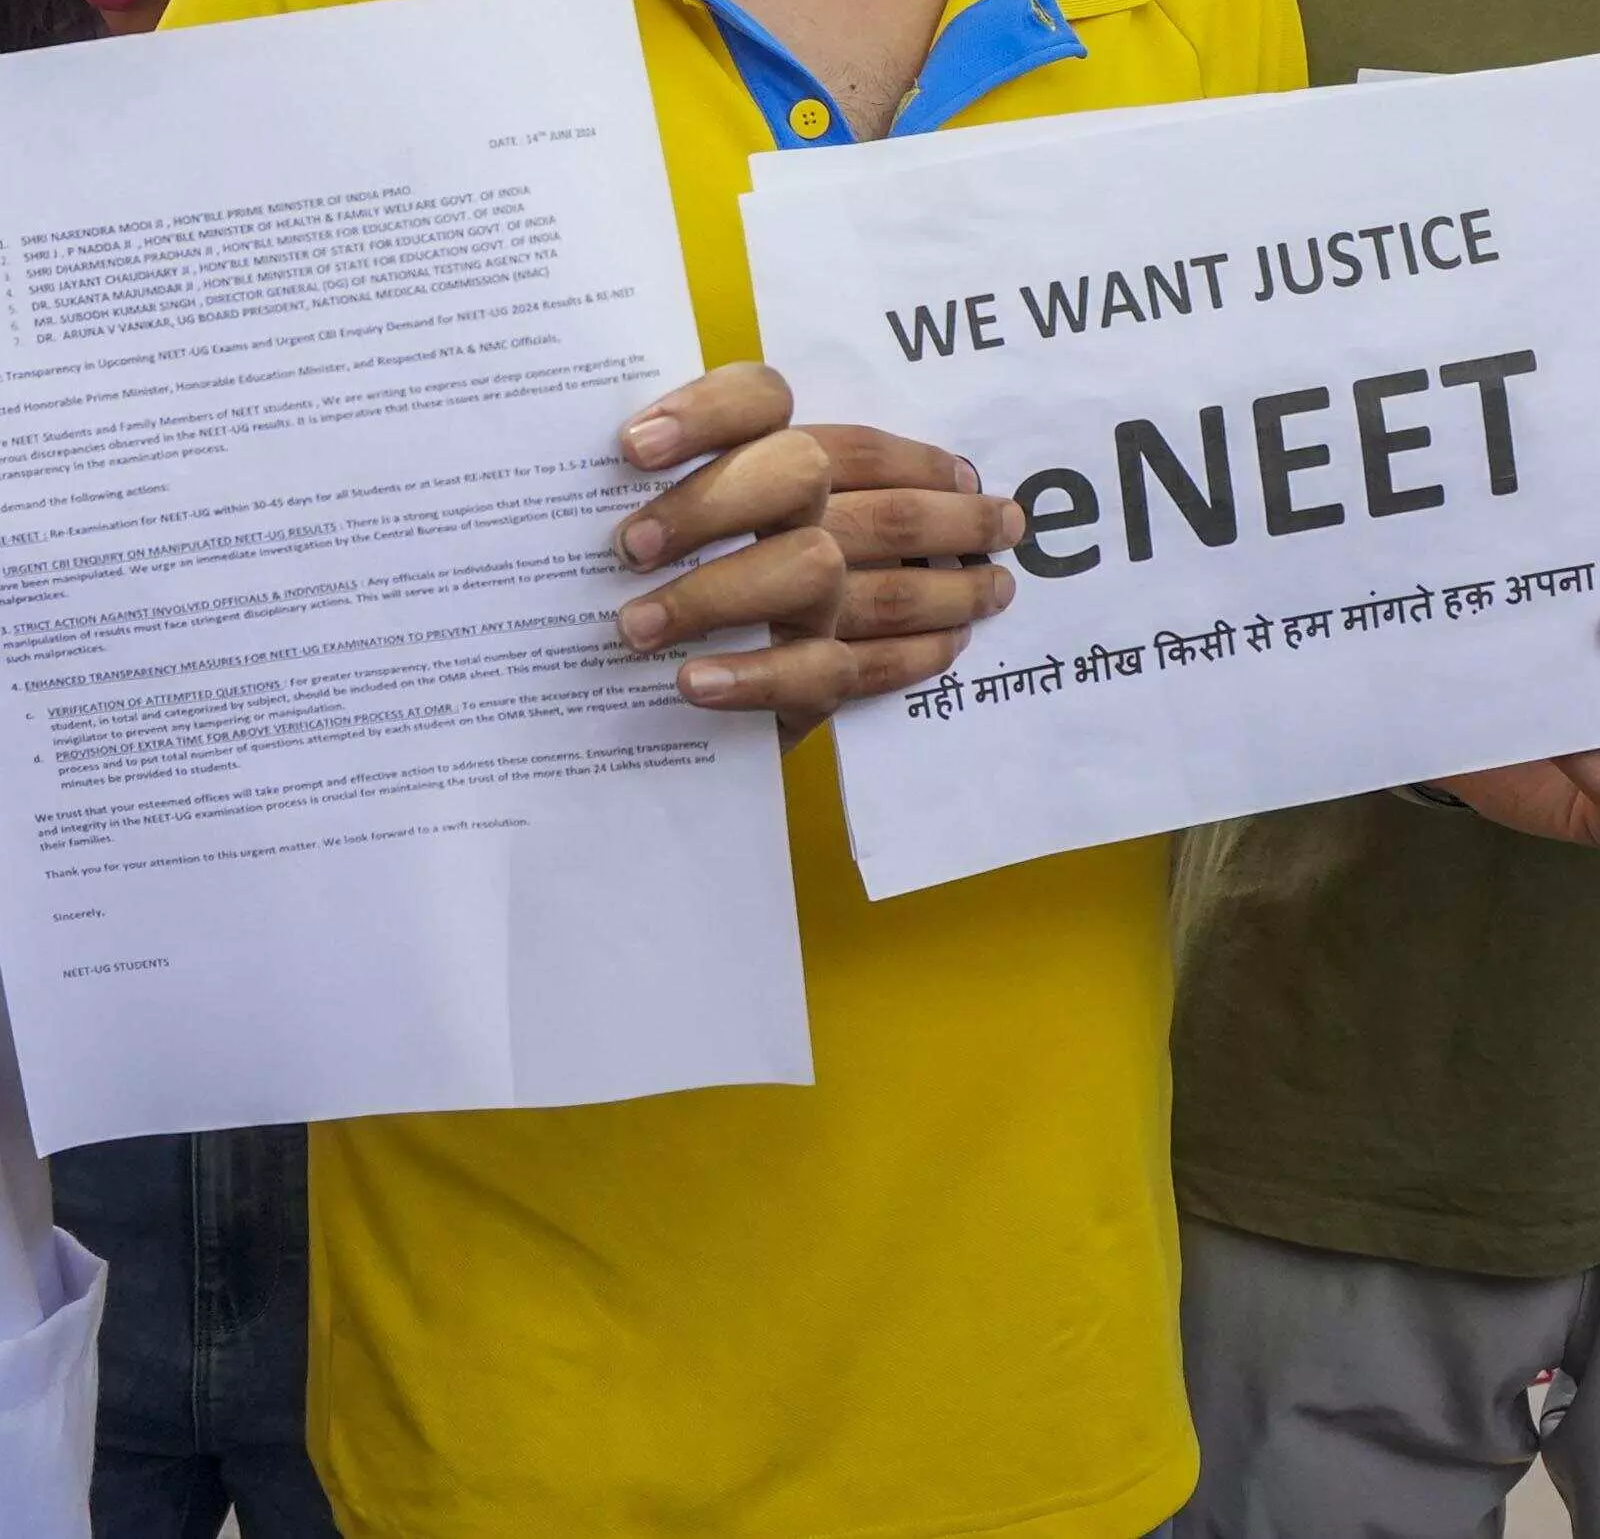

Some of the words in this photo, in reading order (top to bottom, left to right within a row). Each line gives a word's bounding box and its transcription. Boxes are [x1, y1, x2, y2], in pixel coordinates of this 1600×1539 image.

[885, 292, 1004, 362] WE
[1018, 252, 1228, 338] WANT
[1254, 208, 1499, 301] JUSTICE
[0, 498, 46, 512] demand
[48, 497, 67, 505] the
[70, 490, 123, 502] following
[126, 484, 167, 496] actions:
[900, 348, 1538, 579] eNEET
[904, 674, 964, 720] नहीं
[971, 653, 1065, 703] मांगते
[1073, 643, 1145, 683] भीख
[1152, 619, 1236, 669] किसी
[1242, 612, 1274, 652] से
[1280, 609, 1333, 649] हम
[1340, 583, 1434, 631] मांगते
[1505, 562, 1595, 604] अपना
[52, 908, 104, 922] Sincerely,
[62, 964, 110, 978] NEET-UG
[113, 958, 169, 971] STUDENTS
